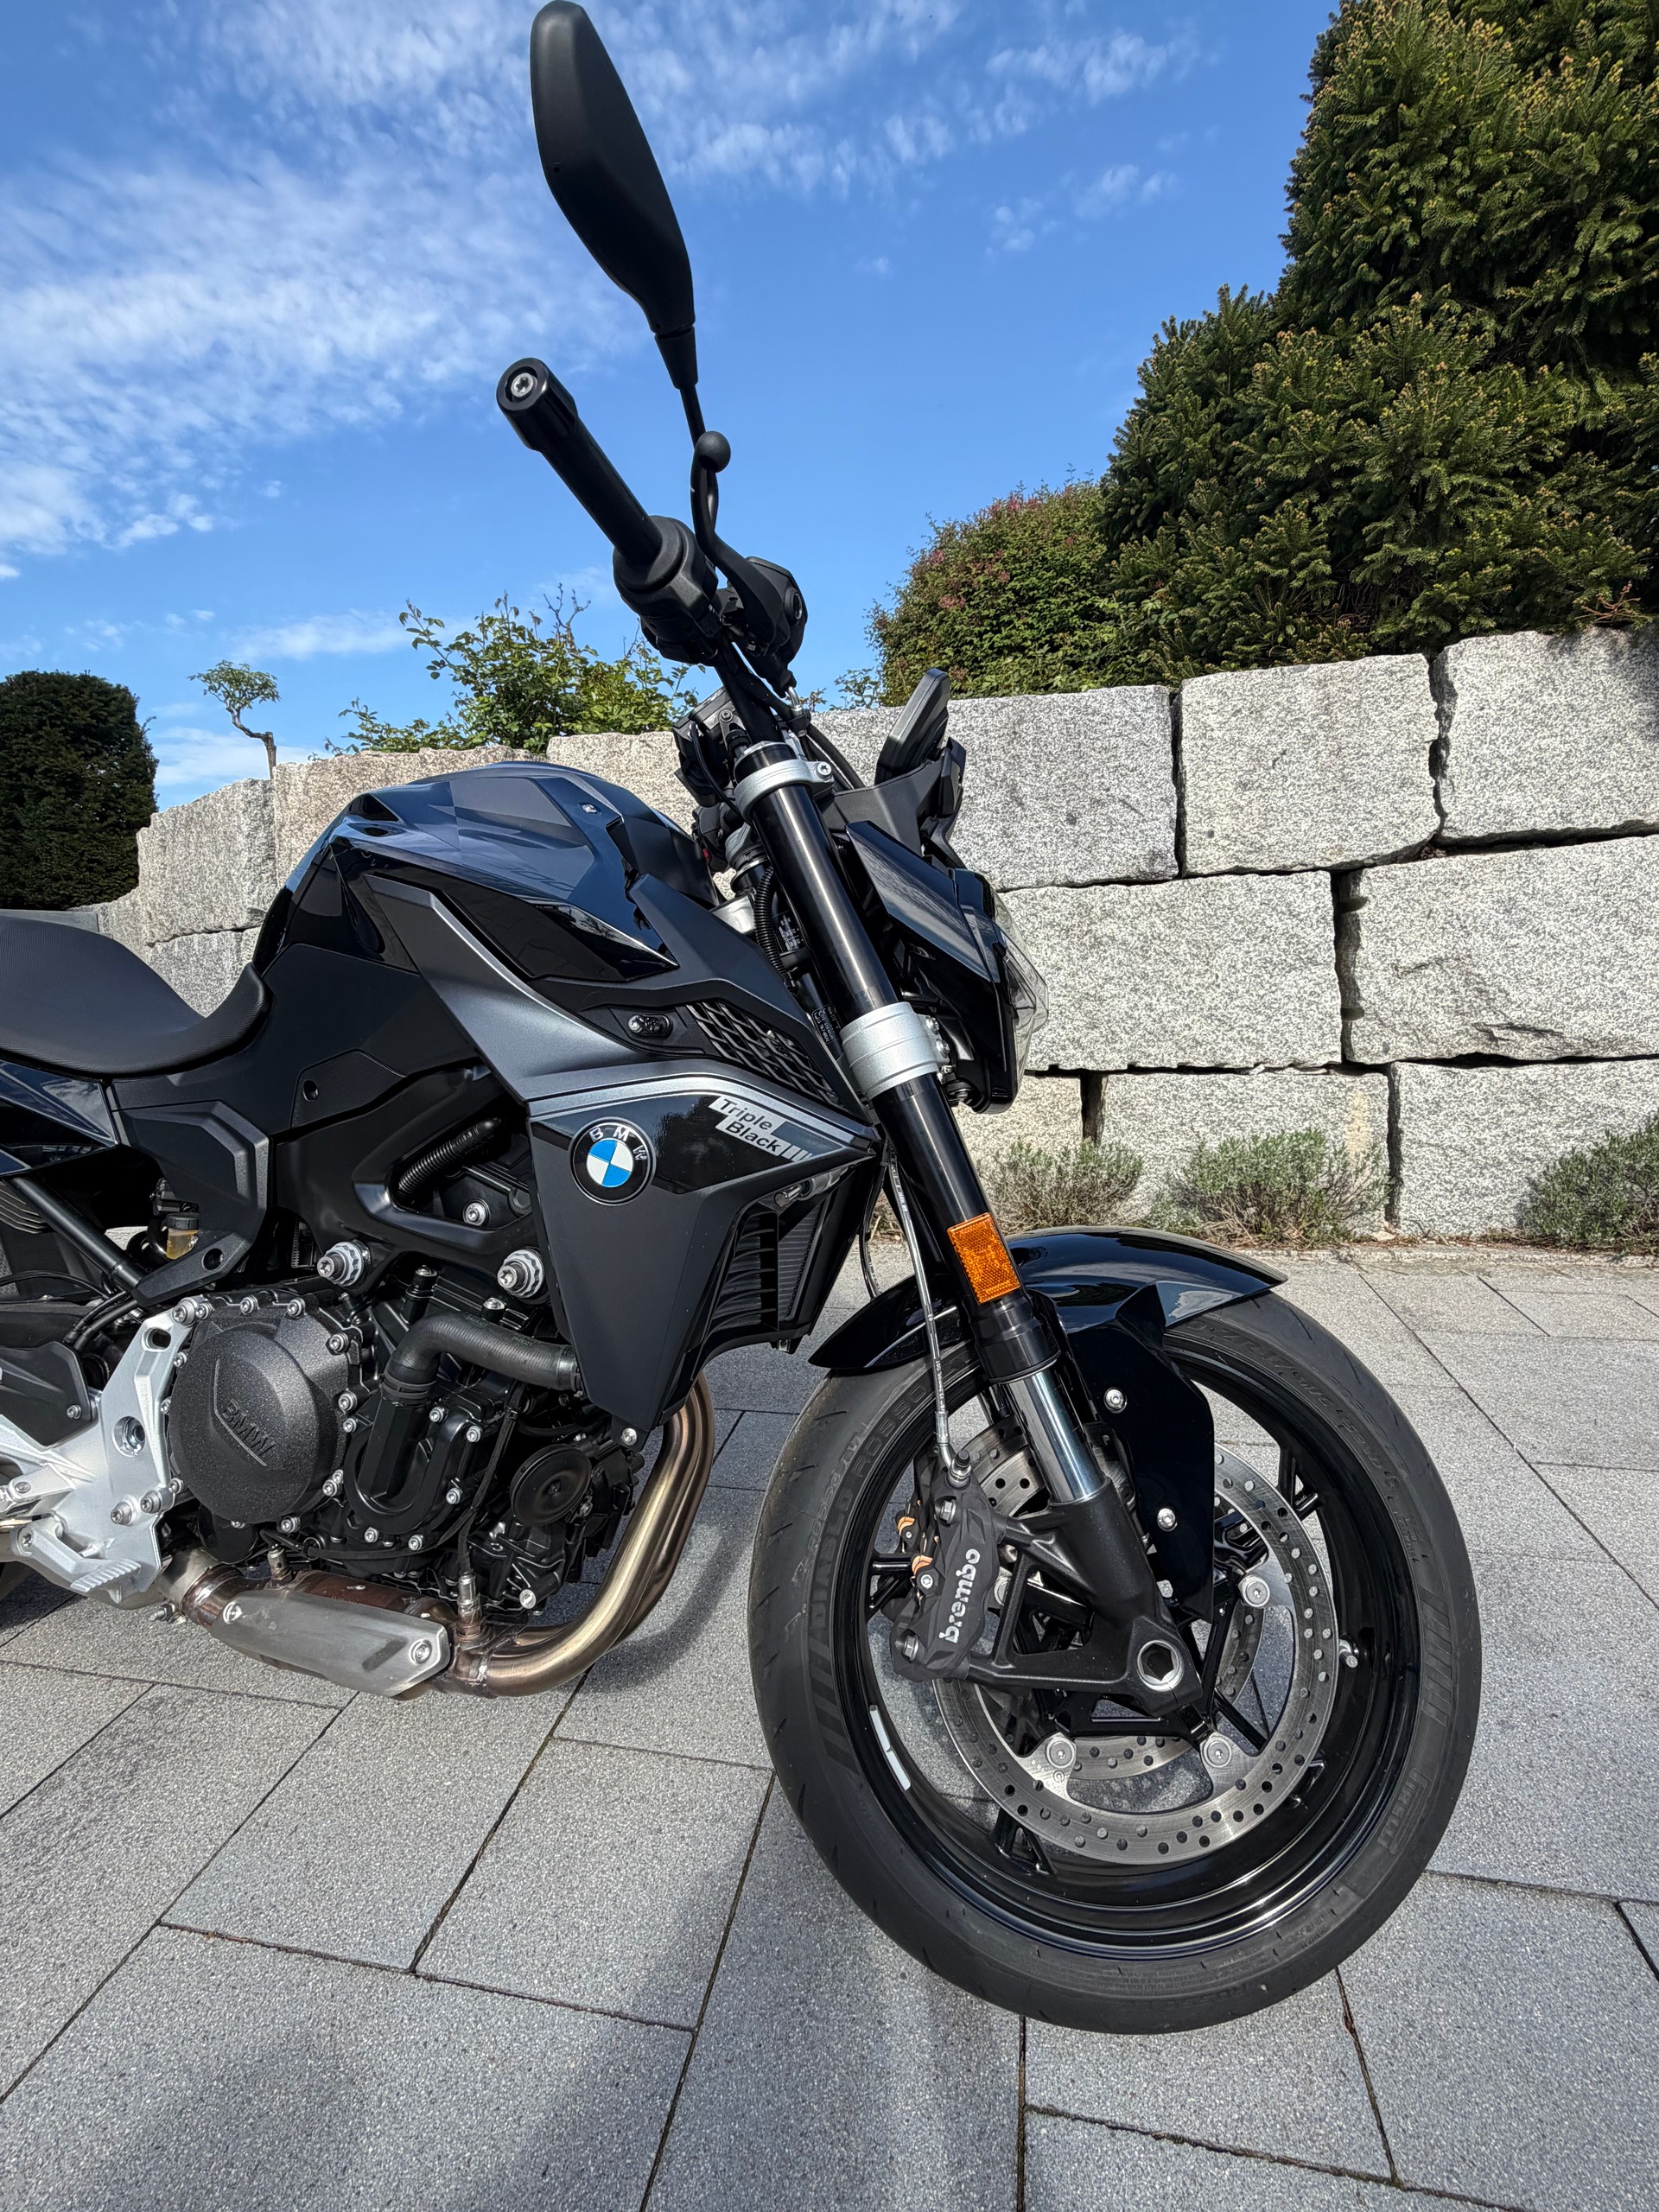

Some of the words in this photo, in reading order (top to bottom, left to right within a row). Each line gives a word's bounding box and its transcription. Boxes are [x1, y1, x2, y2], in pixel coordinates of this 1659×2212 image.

[719, 1098, 773, 1131] Triple
[725, 1120, 782, 1153] Black
[588, 1126, 647, 1160] BMW
[222, 1397, 276, 1457] BMW
[852, 1384, 927, 1478] ROSSO
[938, 1548, 981, 1643] brembo
